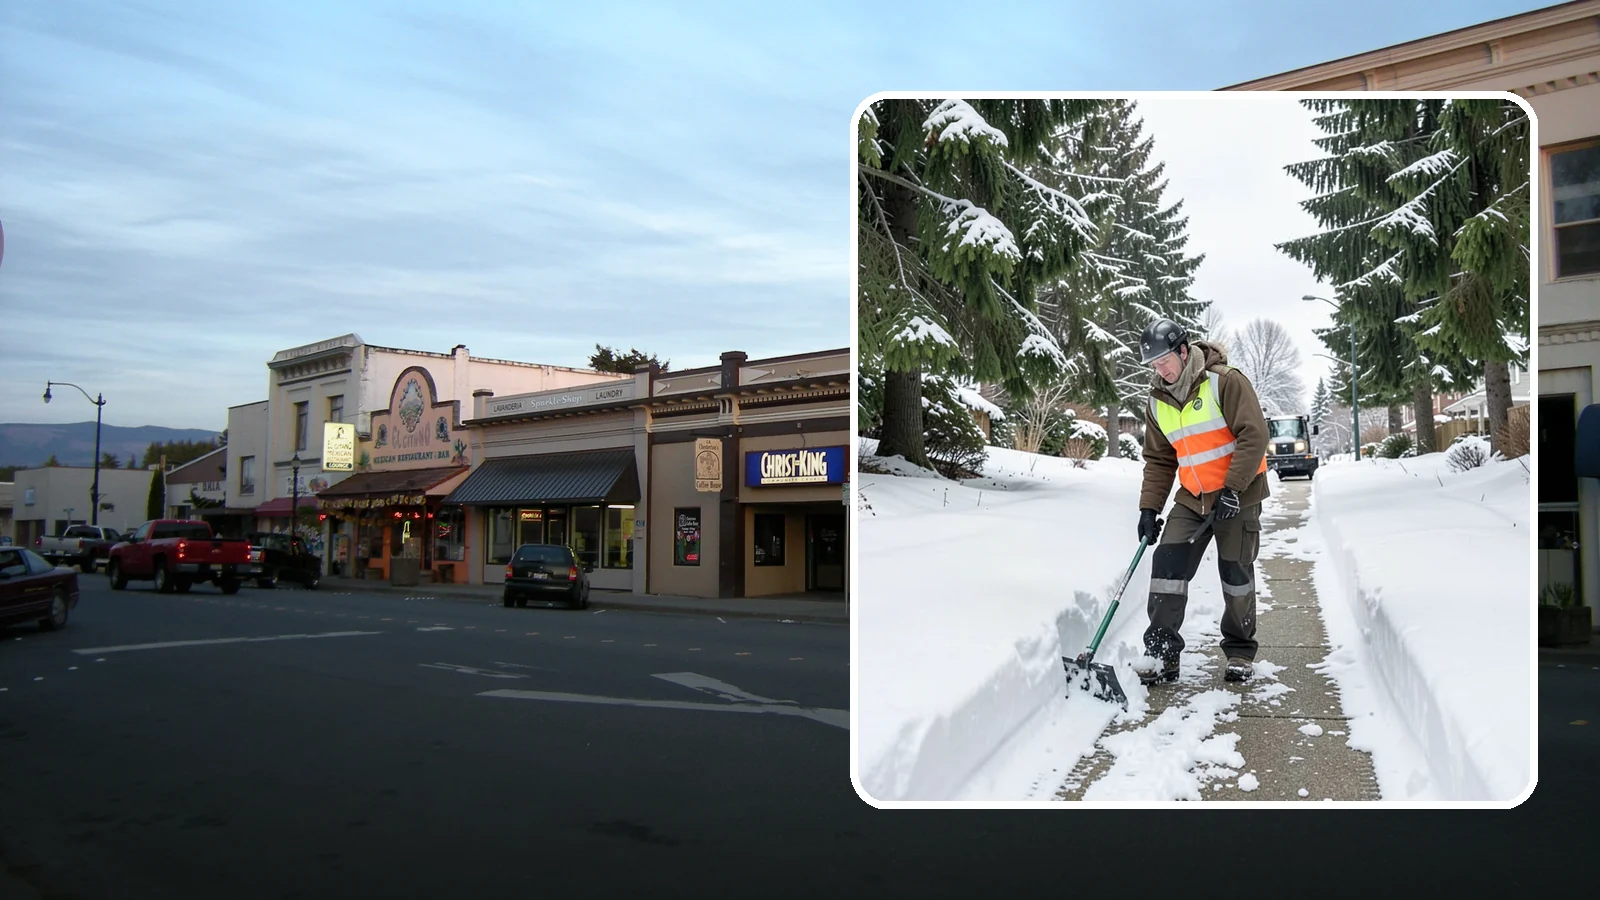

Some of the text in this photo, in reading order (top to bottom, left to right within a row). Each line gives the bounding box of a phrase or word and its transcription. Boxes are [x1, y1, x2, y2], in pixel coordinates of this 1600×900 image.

[561, 394, 582, 407] Shop
[595, 388, 624, 400] LAUNDRY
[493, 402, 523, 413] LAVANDERIA
[373, 454, 397, 465] MEXICAN
[397, 451, 434, 463] RESTAURANT
[437, 449, 451, 459] BAR
[760, 449, 828, 478] CHRIST KING
